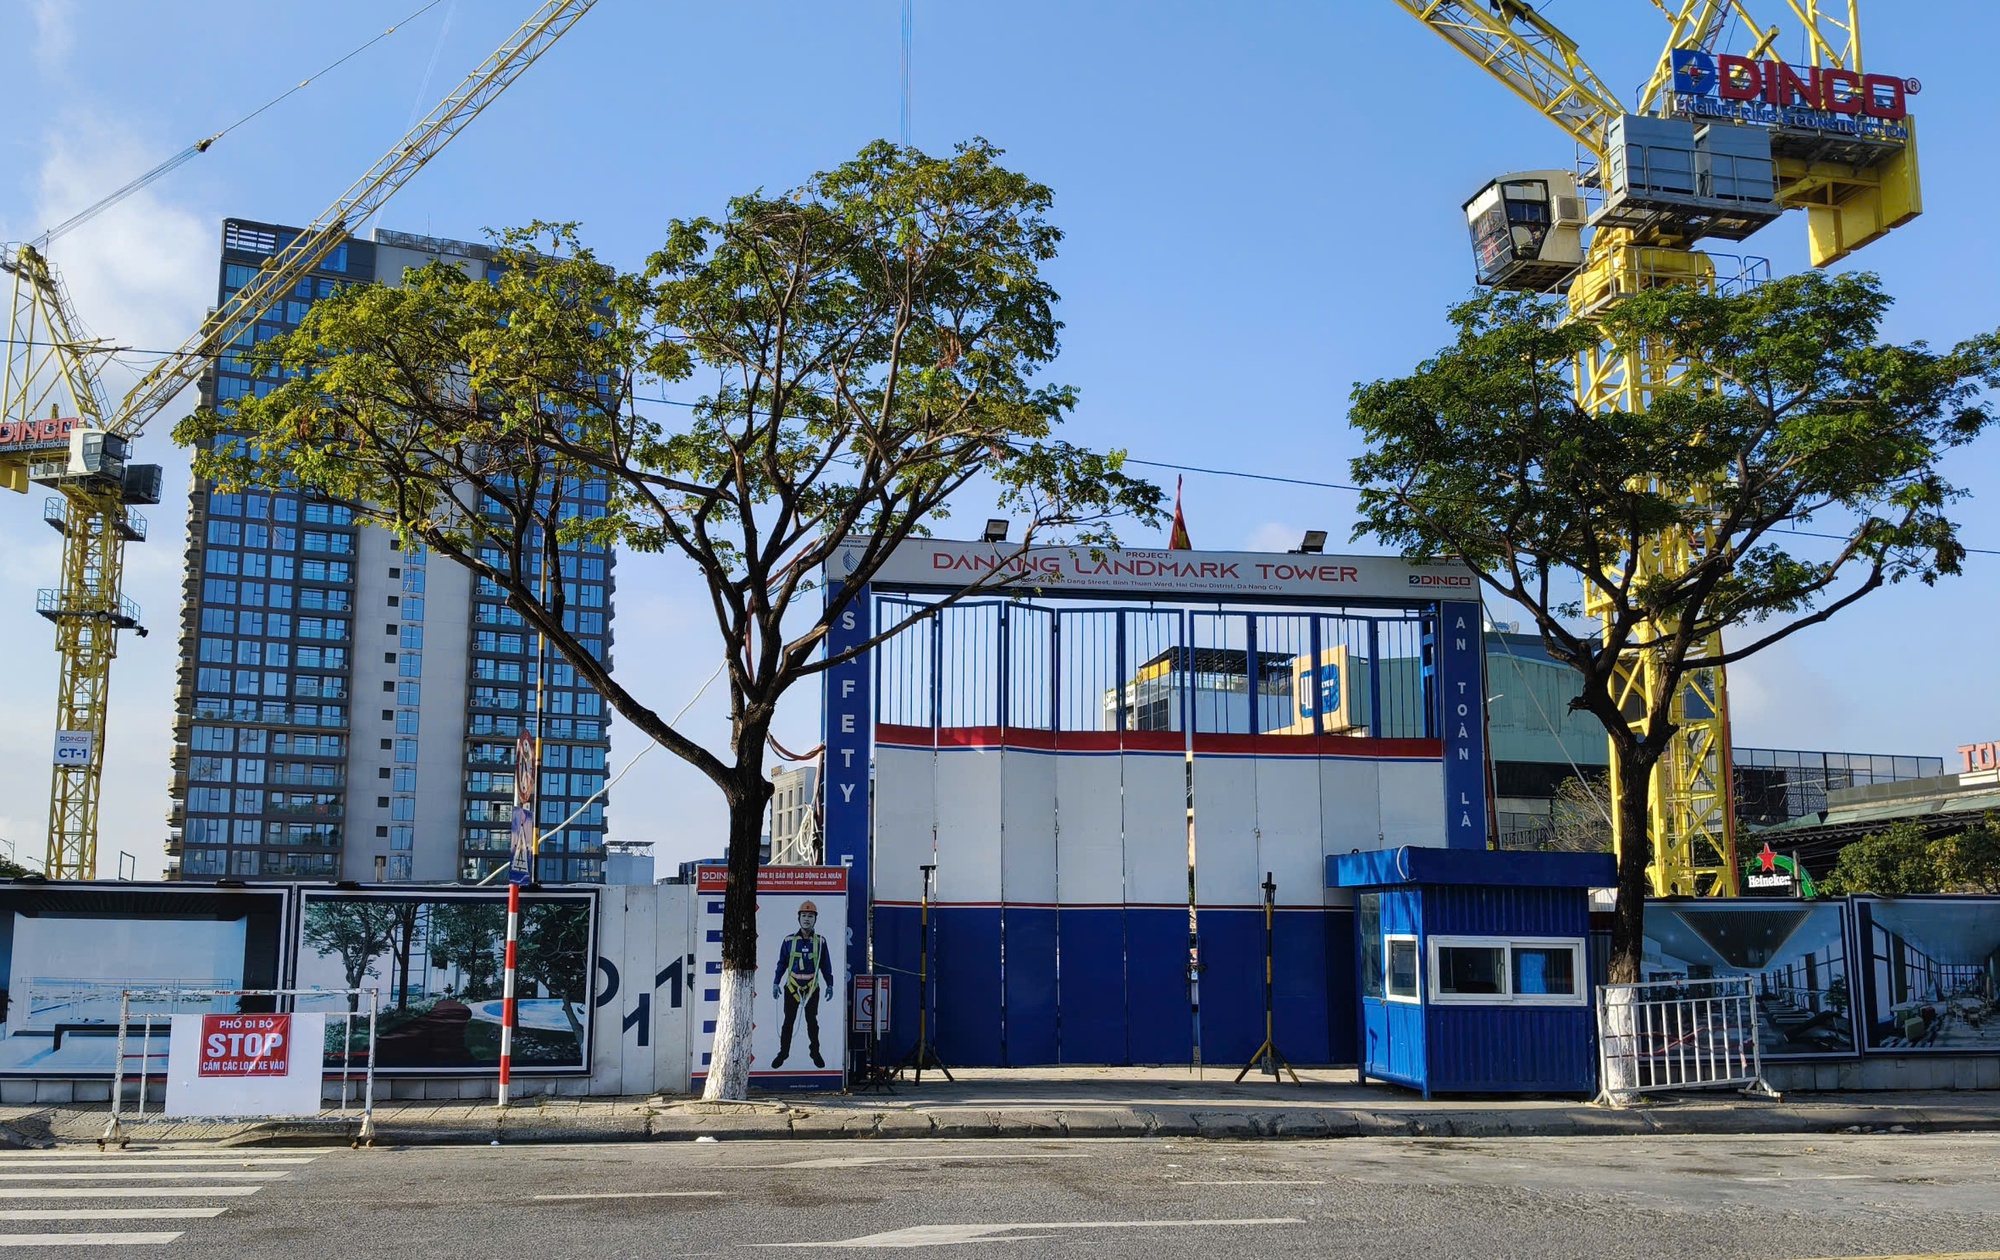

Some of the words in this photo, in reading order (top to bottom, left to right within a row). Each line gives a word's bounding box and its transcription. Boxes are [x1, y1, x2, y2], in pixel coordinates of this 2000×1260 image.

[1717, 53, 1906, 120] DINCO
[1679, 99, 1777, 122] ENGINEERING
[1793, 114, 1909, 140] CONSTRUCTION
[933, 553, 1060, 573] DANANG
[1075, 558, 1240, 579] LANDMARK
[1255, 563, 1358, 583] TOWER
[1125, 551, 1172, 559] PROJECT:
[1153, 580, 1174, 588] Ward,
[1248, 583, 1267, 591] Nang
[1268, 584, 1283, 592] City
[1421, 575, 1471, 586] DINCO
[1456, 616, 1466, 651] AN
[840, 611, 858, 803] SAFETY
[1457, 682, 1469, 760] TOÀN
[58, 748, 87, 759] CT-1
[1957, 742, 2000, 773] TO
[219, 1017, 242, 1029] PHỐ
[245, 1020, 255, 1029] ĐI
[258, 1017, 274, 1031] BỘ
[207, 1033, 283, 1057] STOP
[203, 1058, 220, 1071] CẤM
[222, 1058, 238, 1071] CÁC
[258, 1060, 267, 1070] XE
[269, 1058, 285, 1071] VÀO
